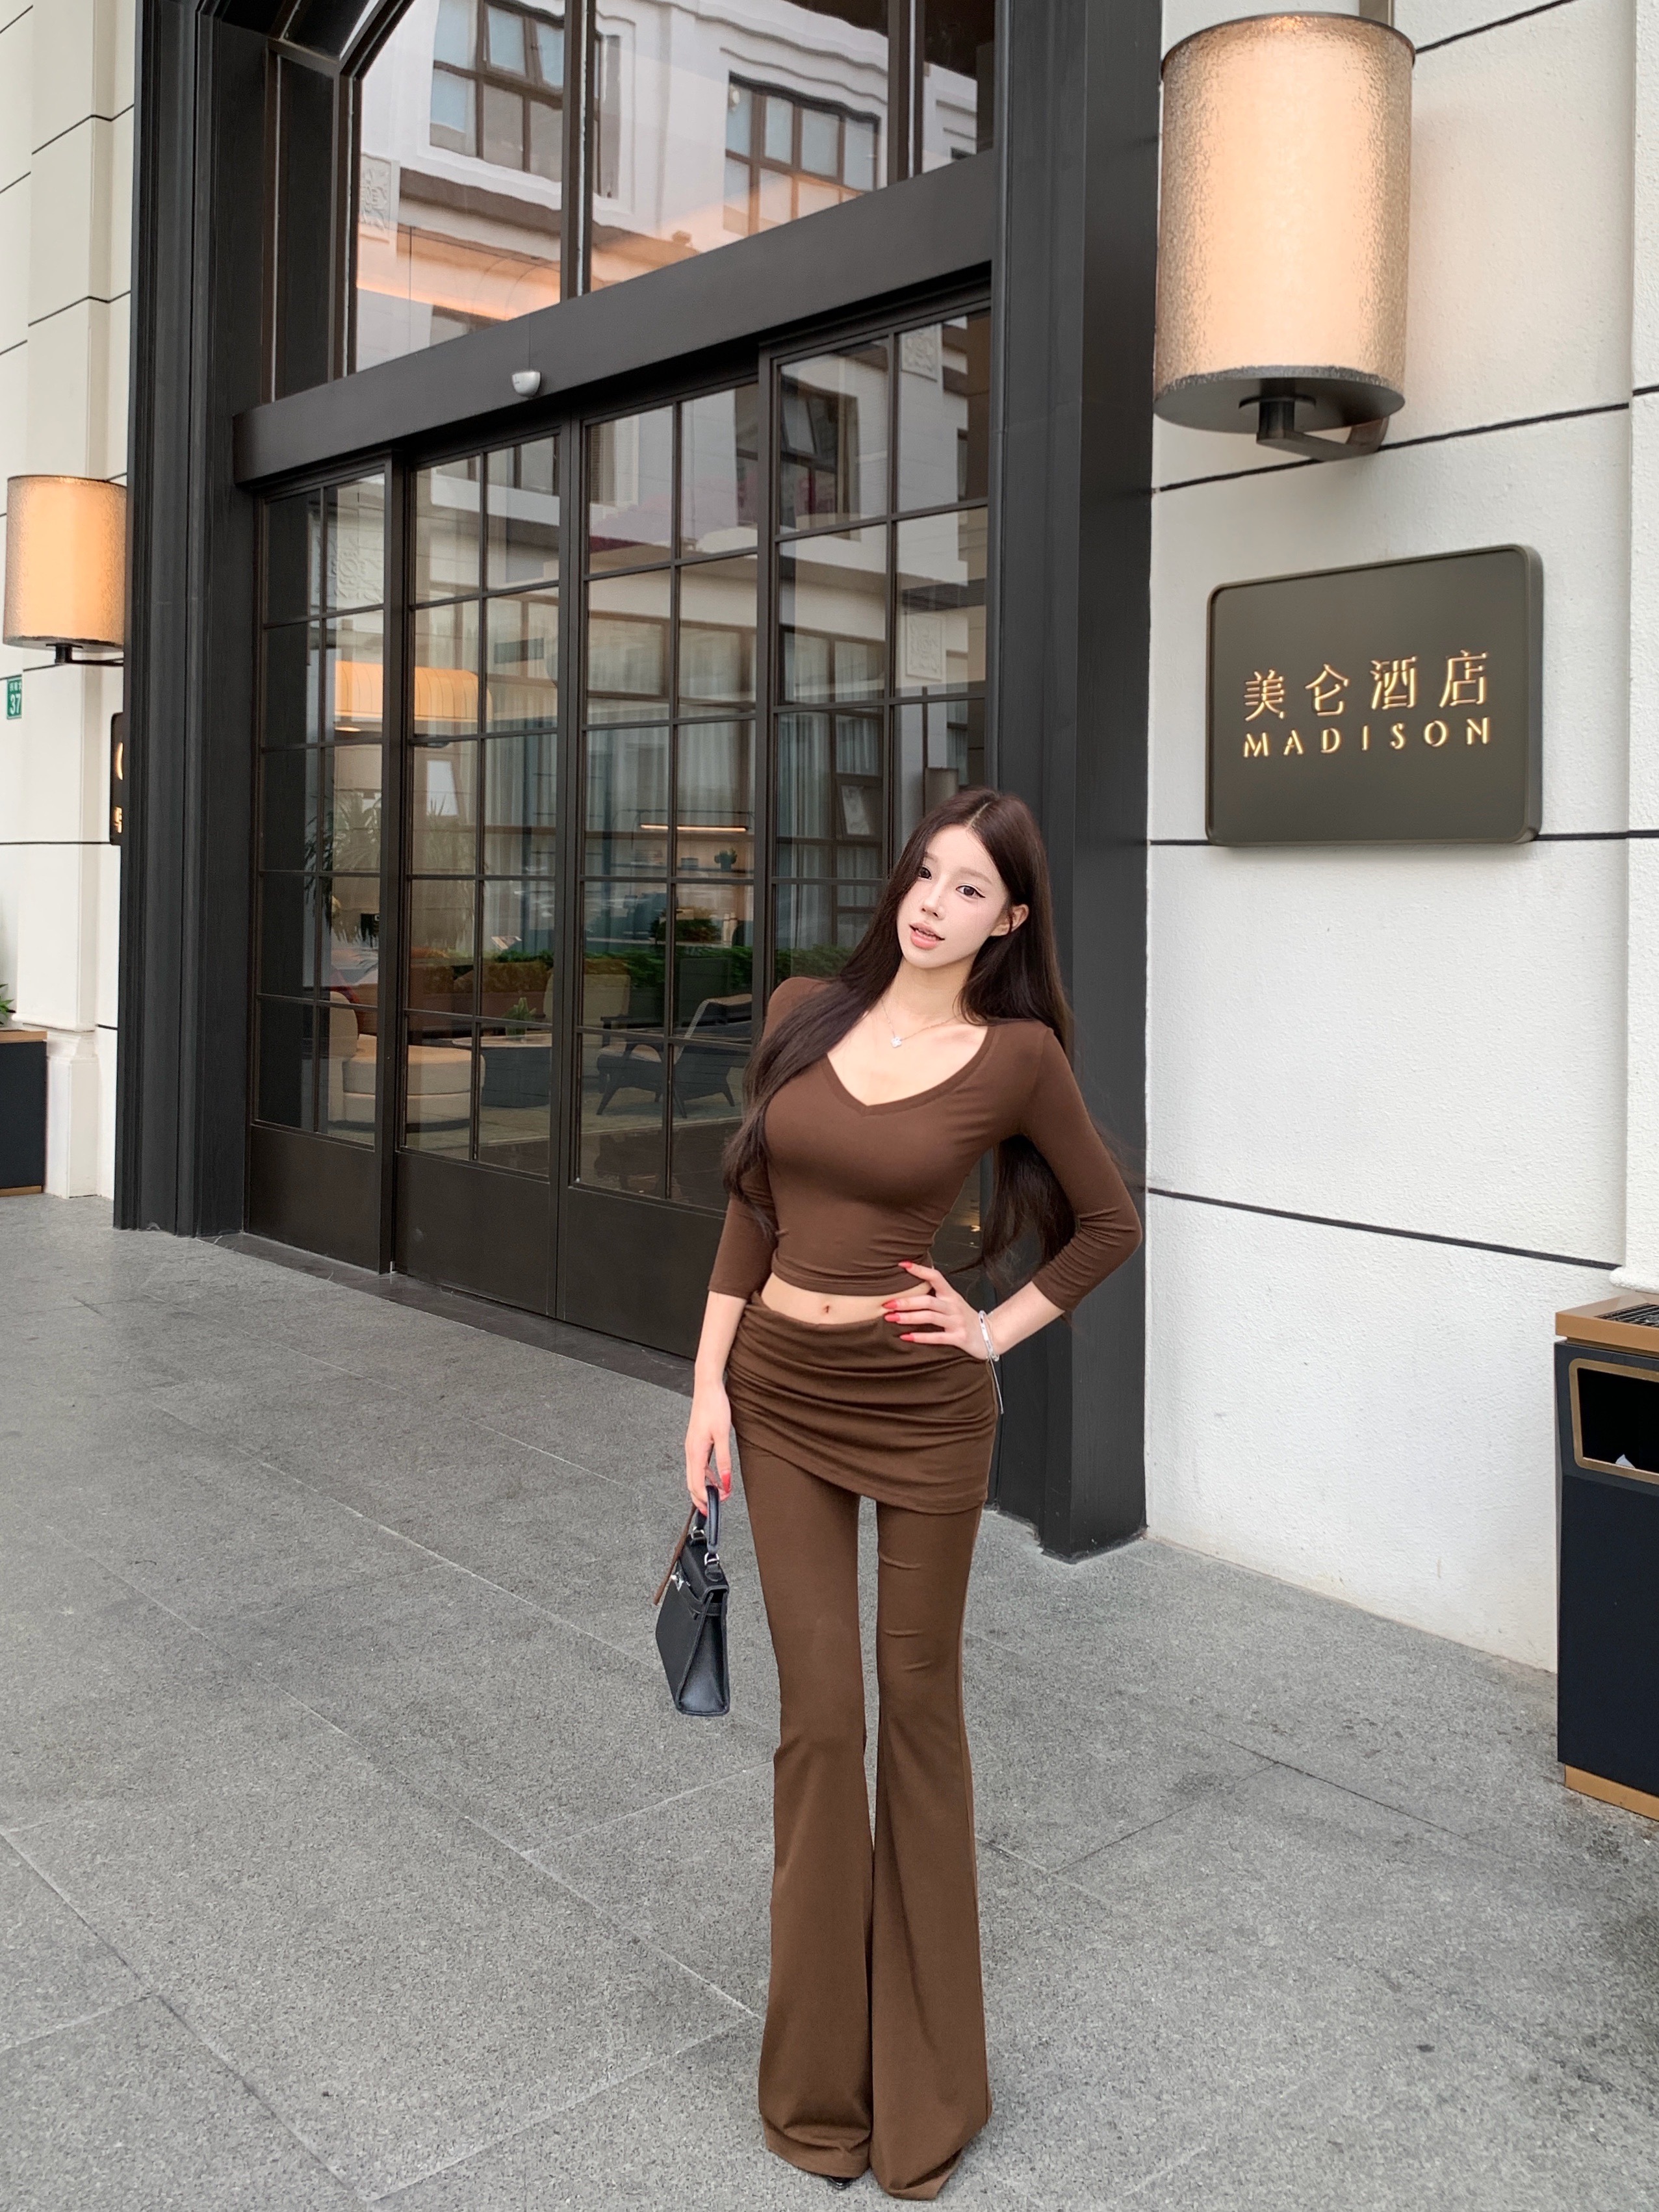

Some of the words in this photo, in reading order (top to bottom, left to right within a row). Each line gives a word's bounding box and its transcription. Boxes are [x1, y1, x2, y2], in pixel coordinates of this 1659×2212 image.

[1243, 649, 1488, 722] 美仑酒店
[1242, 717, 1490, 758] MADISON
